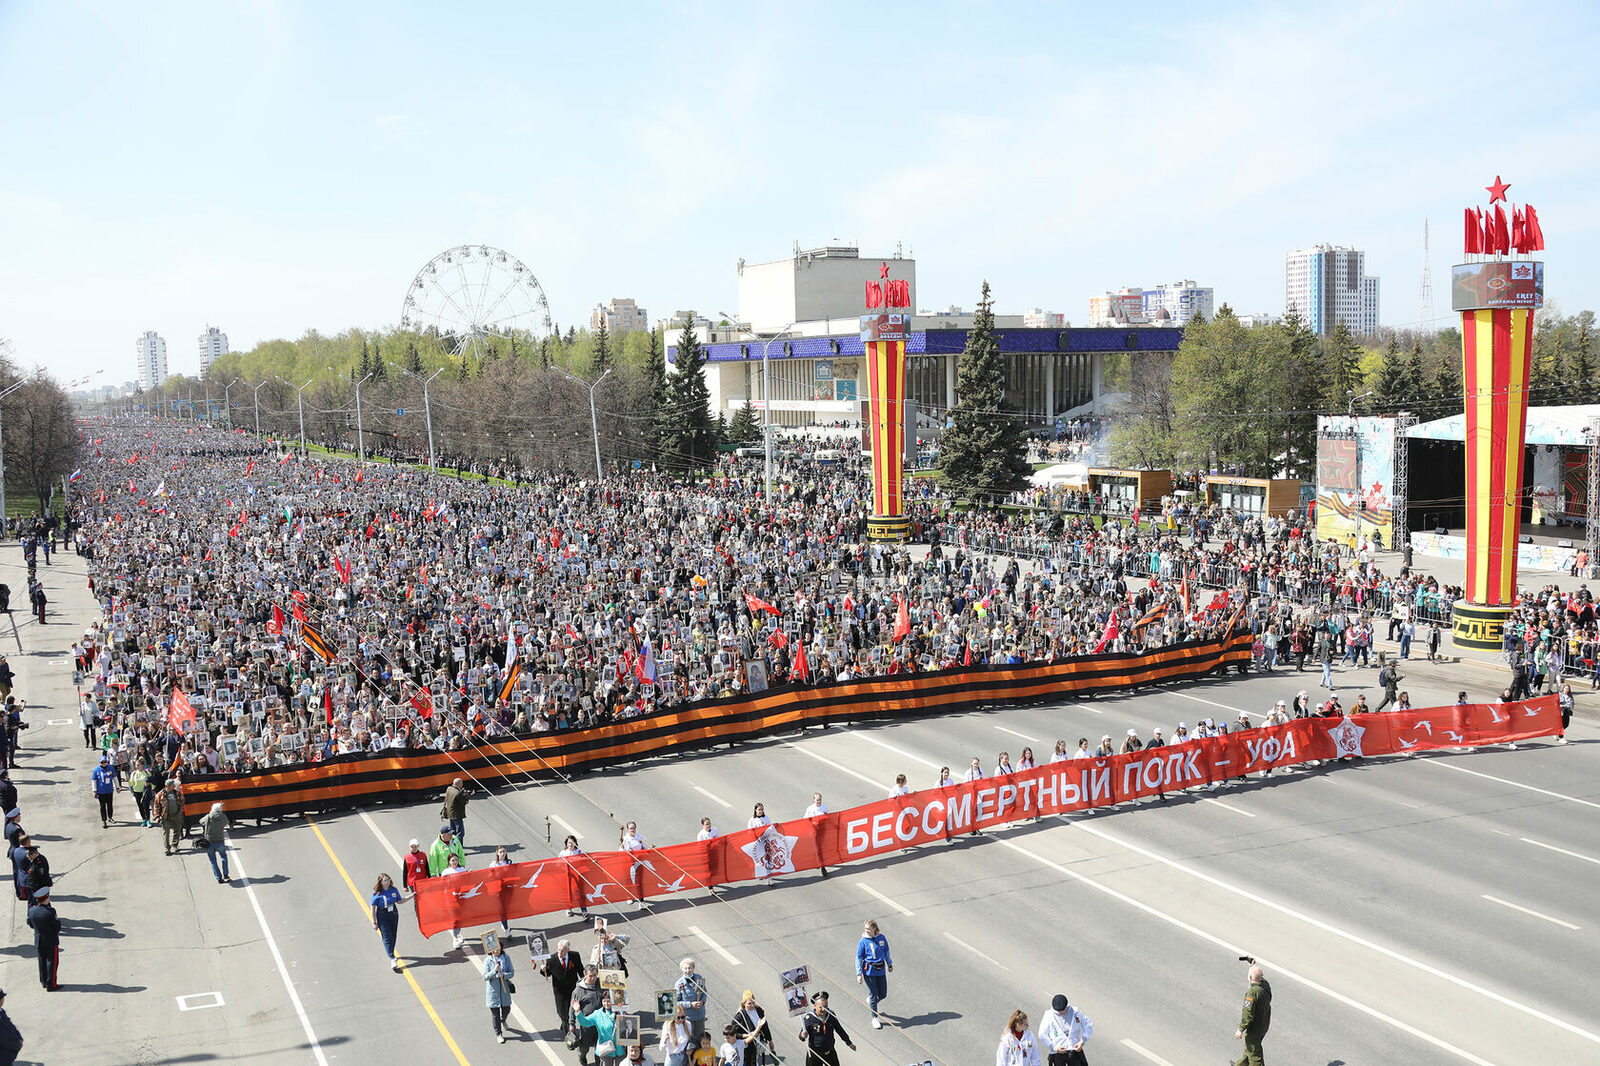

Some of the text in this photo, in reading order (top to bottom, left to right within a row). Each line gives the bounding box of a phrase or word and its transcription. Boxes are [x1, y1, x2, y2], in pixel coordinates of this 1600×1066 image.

[847, 760, 1111, 854] БЕССМЕРТНЫЙ
[1123, 748, 1202, 795] ПОЛК
[1245, 731, 1296, 768] УФА
